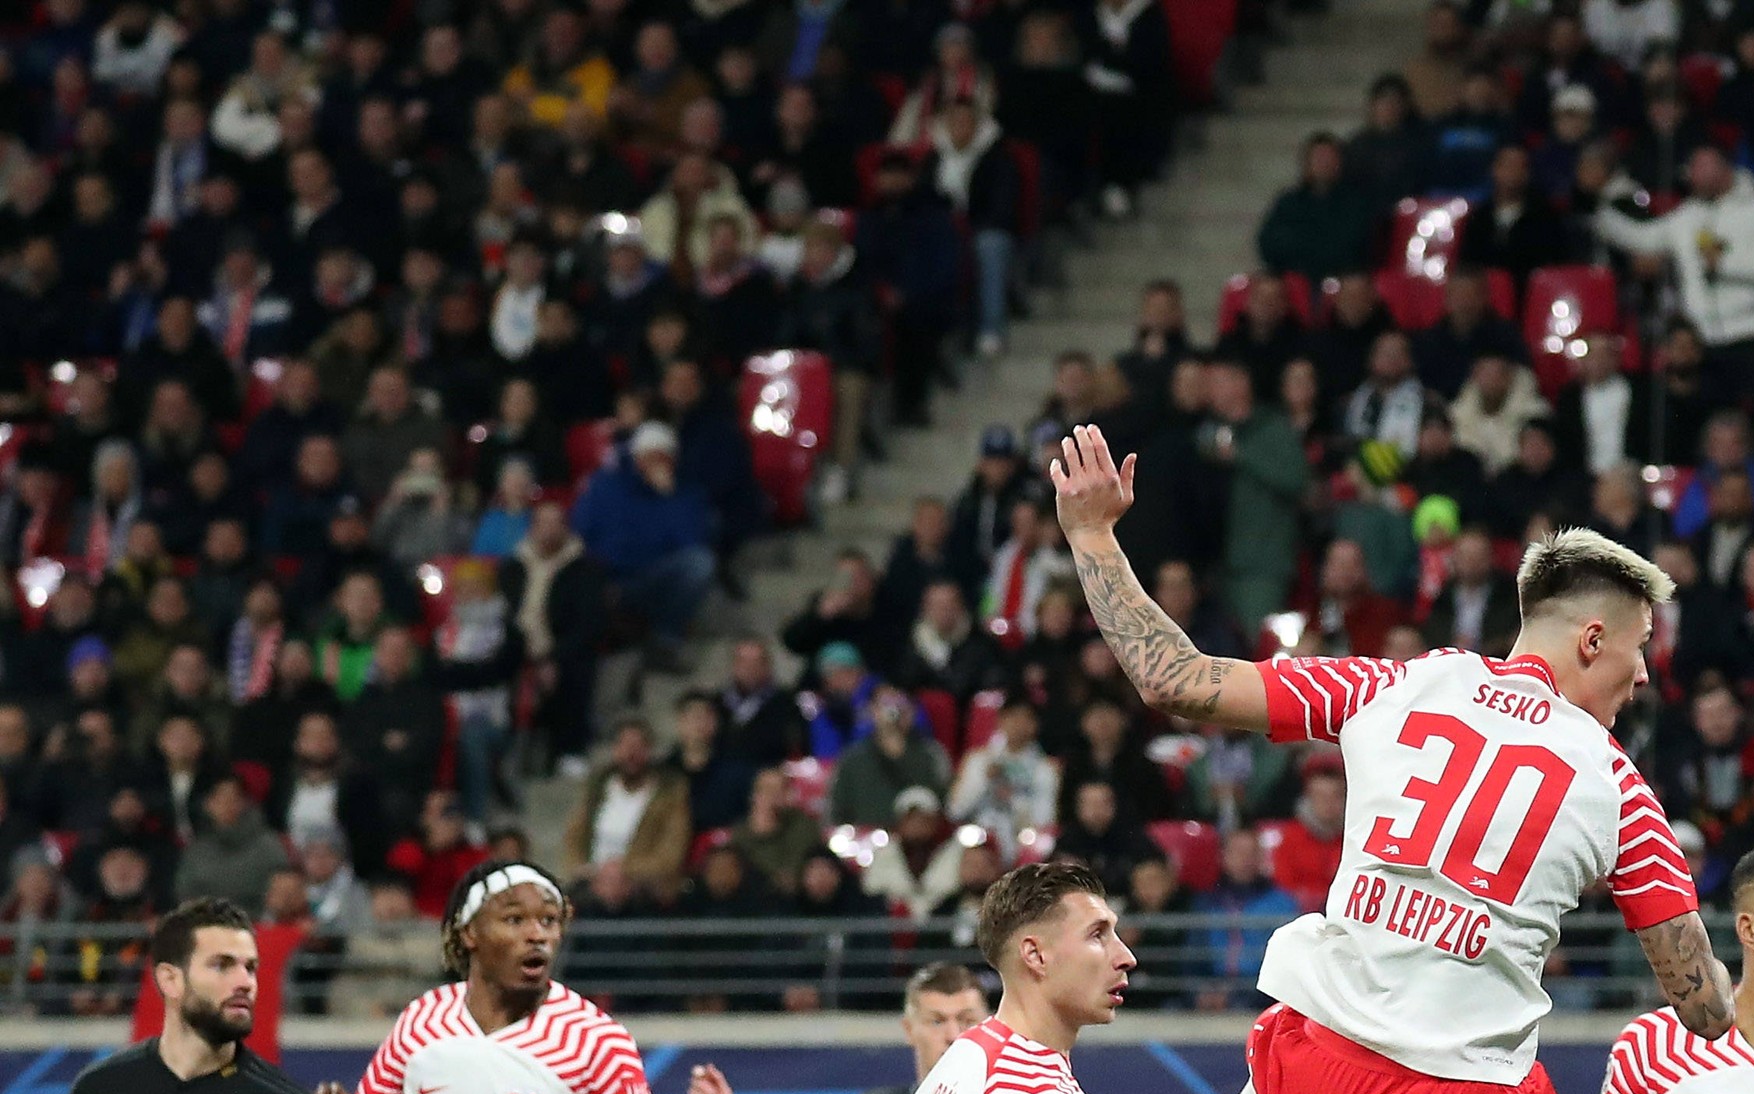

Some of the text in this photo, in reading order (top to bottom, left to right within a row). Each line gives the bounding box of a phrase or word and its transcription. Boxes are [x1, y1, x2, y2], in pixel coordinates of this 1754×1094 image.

[1363, 711, 1577, 907] 30
[1343, 873, 1492, 961] RB LEIPZIG
